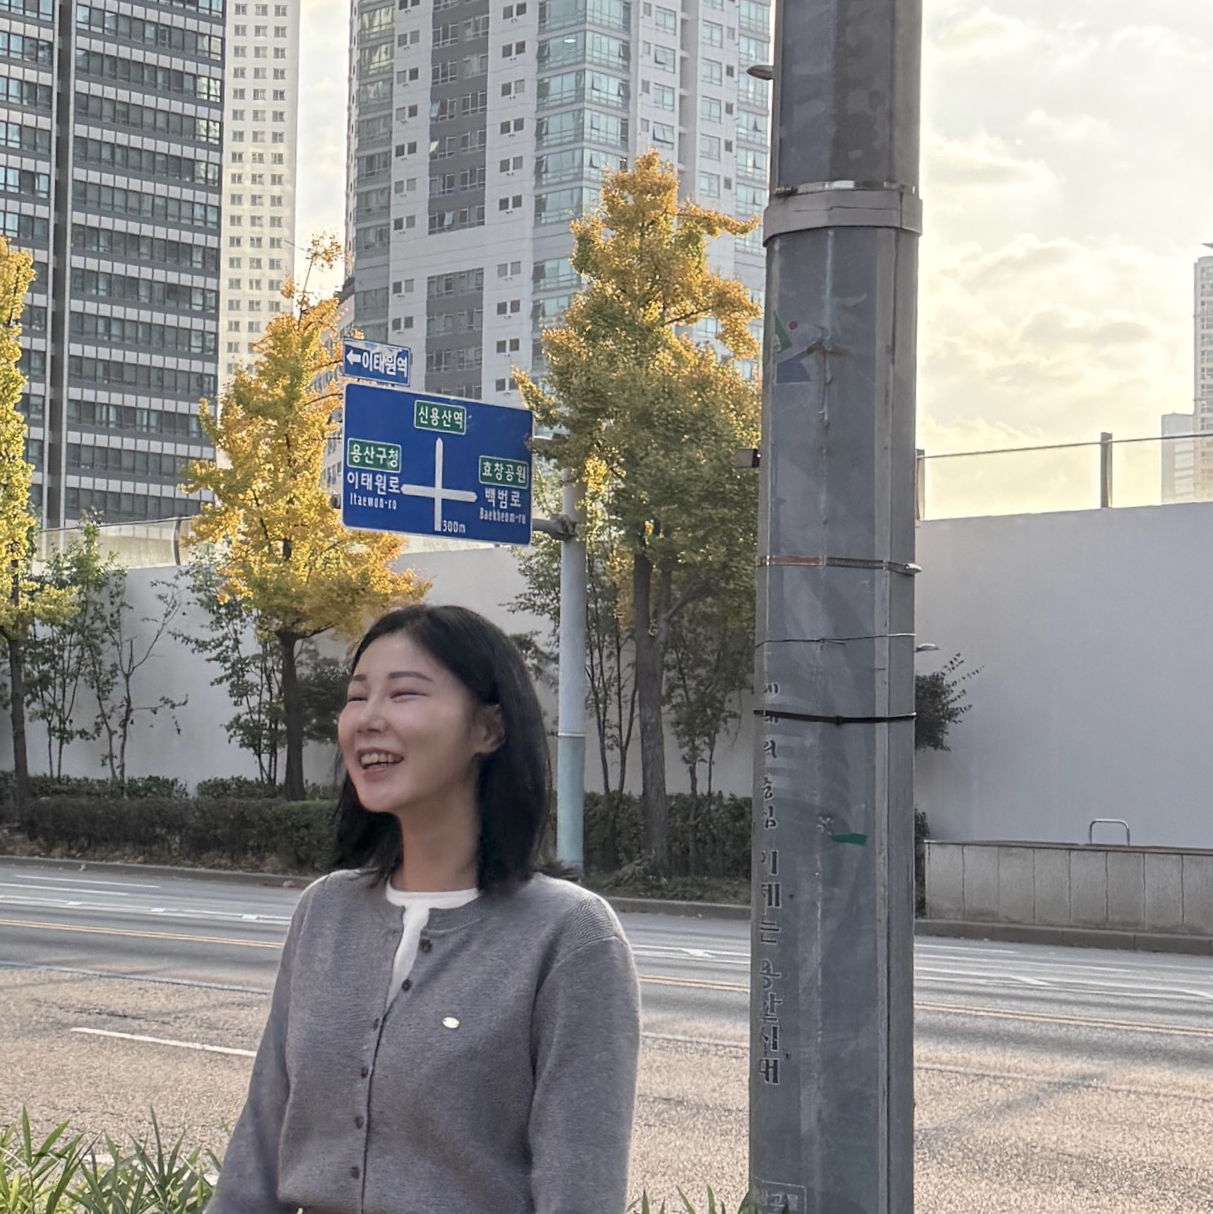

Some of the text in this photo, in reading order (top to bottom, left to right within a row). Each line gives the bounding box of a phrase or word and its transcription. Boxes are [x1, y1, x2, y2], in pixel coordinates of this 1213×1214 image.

[362, 351, 408, 378] 이태원역
[418, 406, 463, 429] 신용산역
[350, 444, 399, 467] 용산구청
[347, 471, 400, 495] 이태원로
[482, 461, 526, 483] 효창공원
[350, 492, 397, 510] Itaewon-ro
[484, 487, 521, 509] 백범로
[442, 520, 465, 534] 300m
[479, 507, 526, 525] Baekbeom-ro
